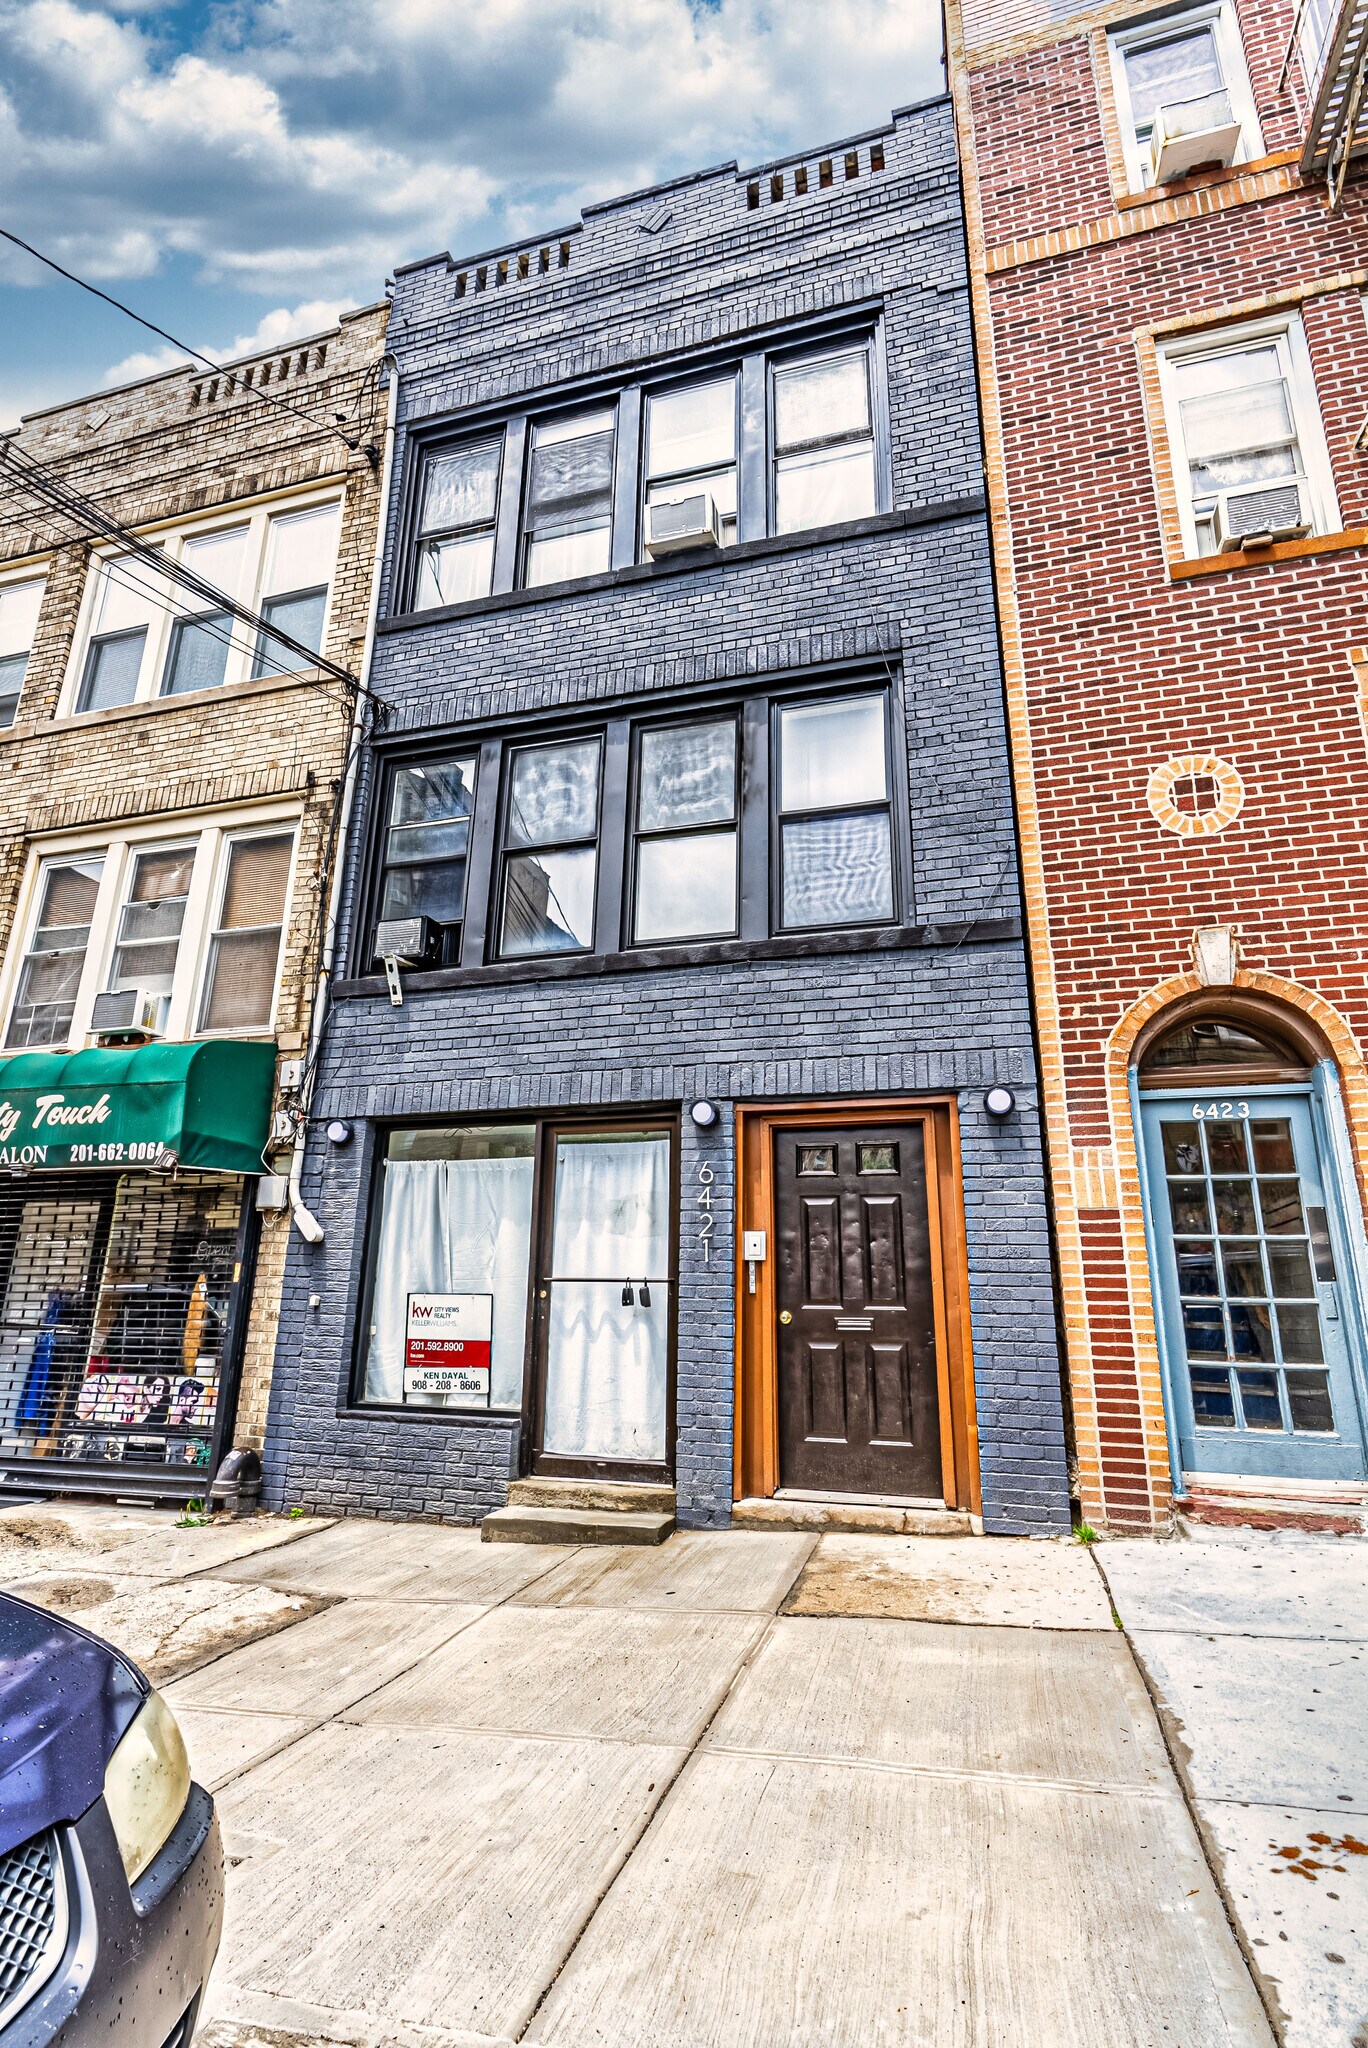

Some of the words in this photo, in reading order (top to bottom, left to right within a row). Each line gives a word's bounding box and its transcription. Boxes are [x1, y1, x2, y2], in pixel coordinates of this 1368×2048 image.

[32, 1093, 112, 1129] Touch
[1192, 1102, 1250, 1119] 6423
[70, 1141, 164, 1162] 201-662-0064
[697, 1161, 714, 1263] 6421
[412, 1301, 433, 1318] kw
[411, 1341, 464, 1352] 201.592.8900
[412, 1380, 427, 1390] 908
[435, 1380, 451, 1390] 208
[460, 1380, 481, 1390] 8606
